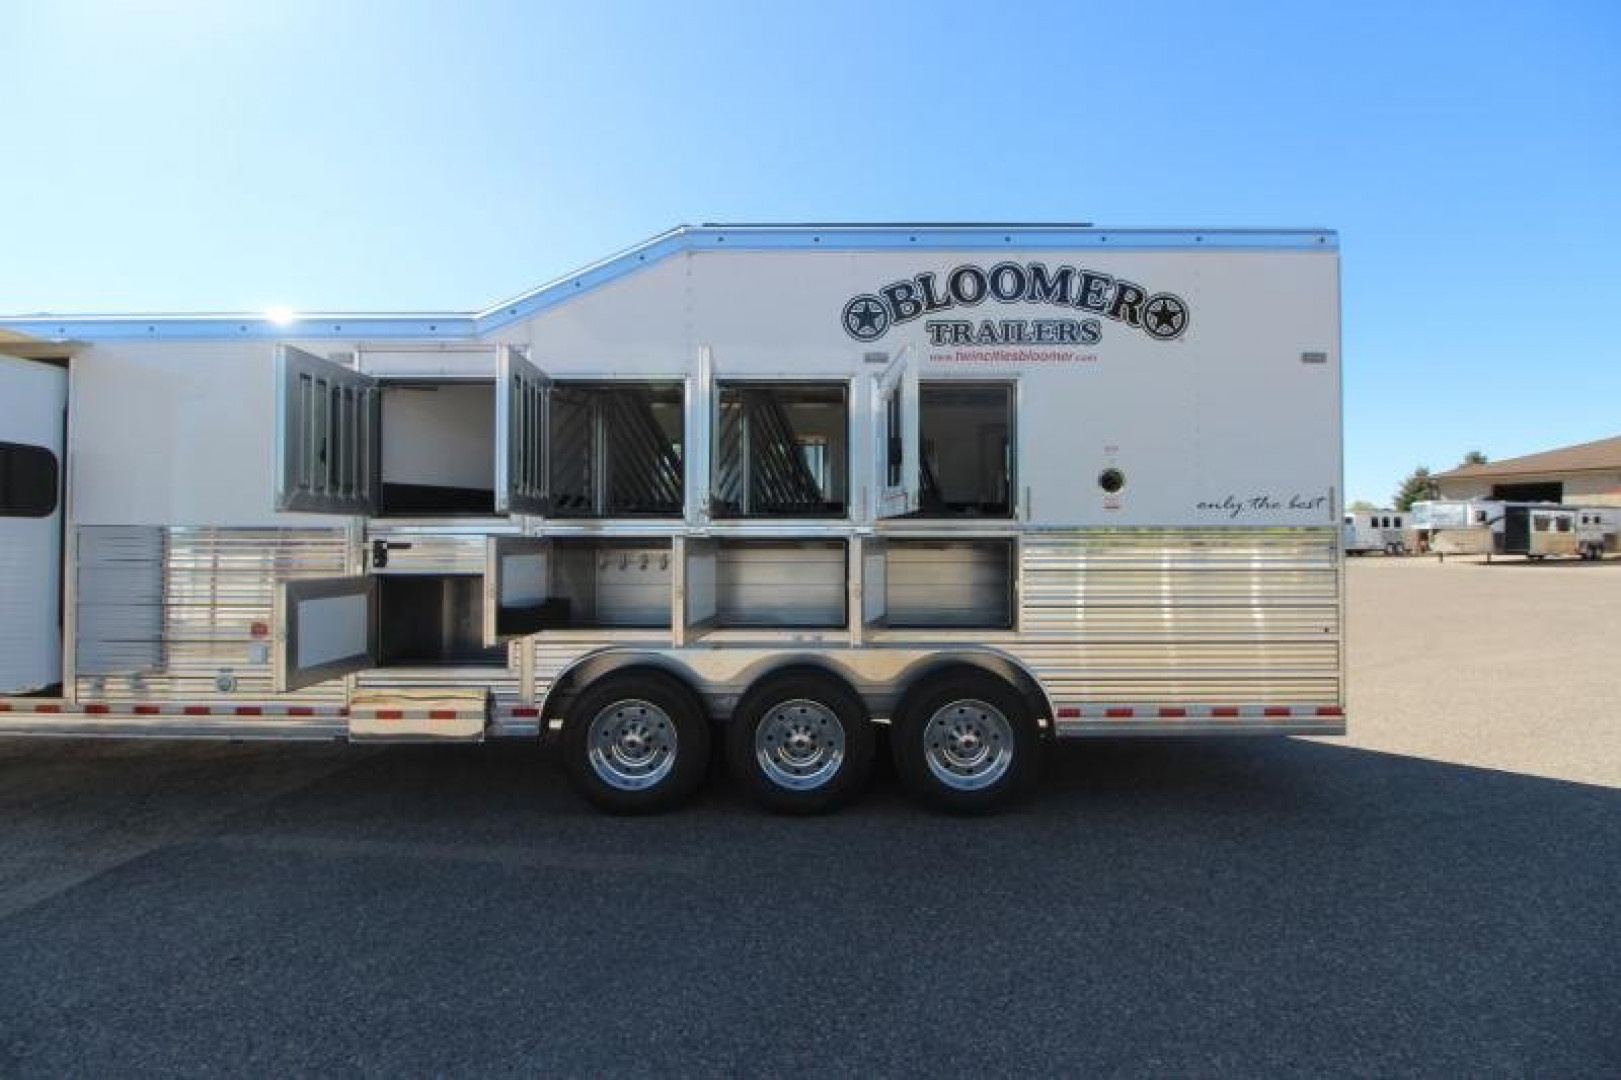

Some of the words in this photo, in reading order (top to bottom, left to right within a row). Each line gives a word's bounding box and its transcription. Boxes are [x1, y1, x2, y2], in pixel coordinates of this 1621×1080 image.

[880, 261, 1148, 329] BLOOMER
[925, 319, 1102, 346] TRAILERS
[1196, 494, 1243, 518] only
[1247, 495, 1281, 510] the
[1288, 494, 1326, 511] best
